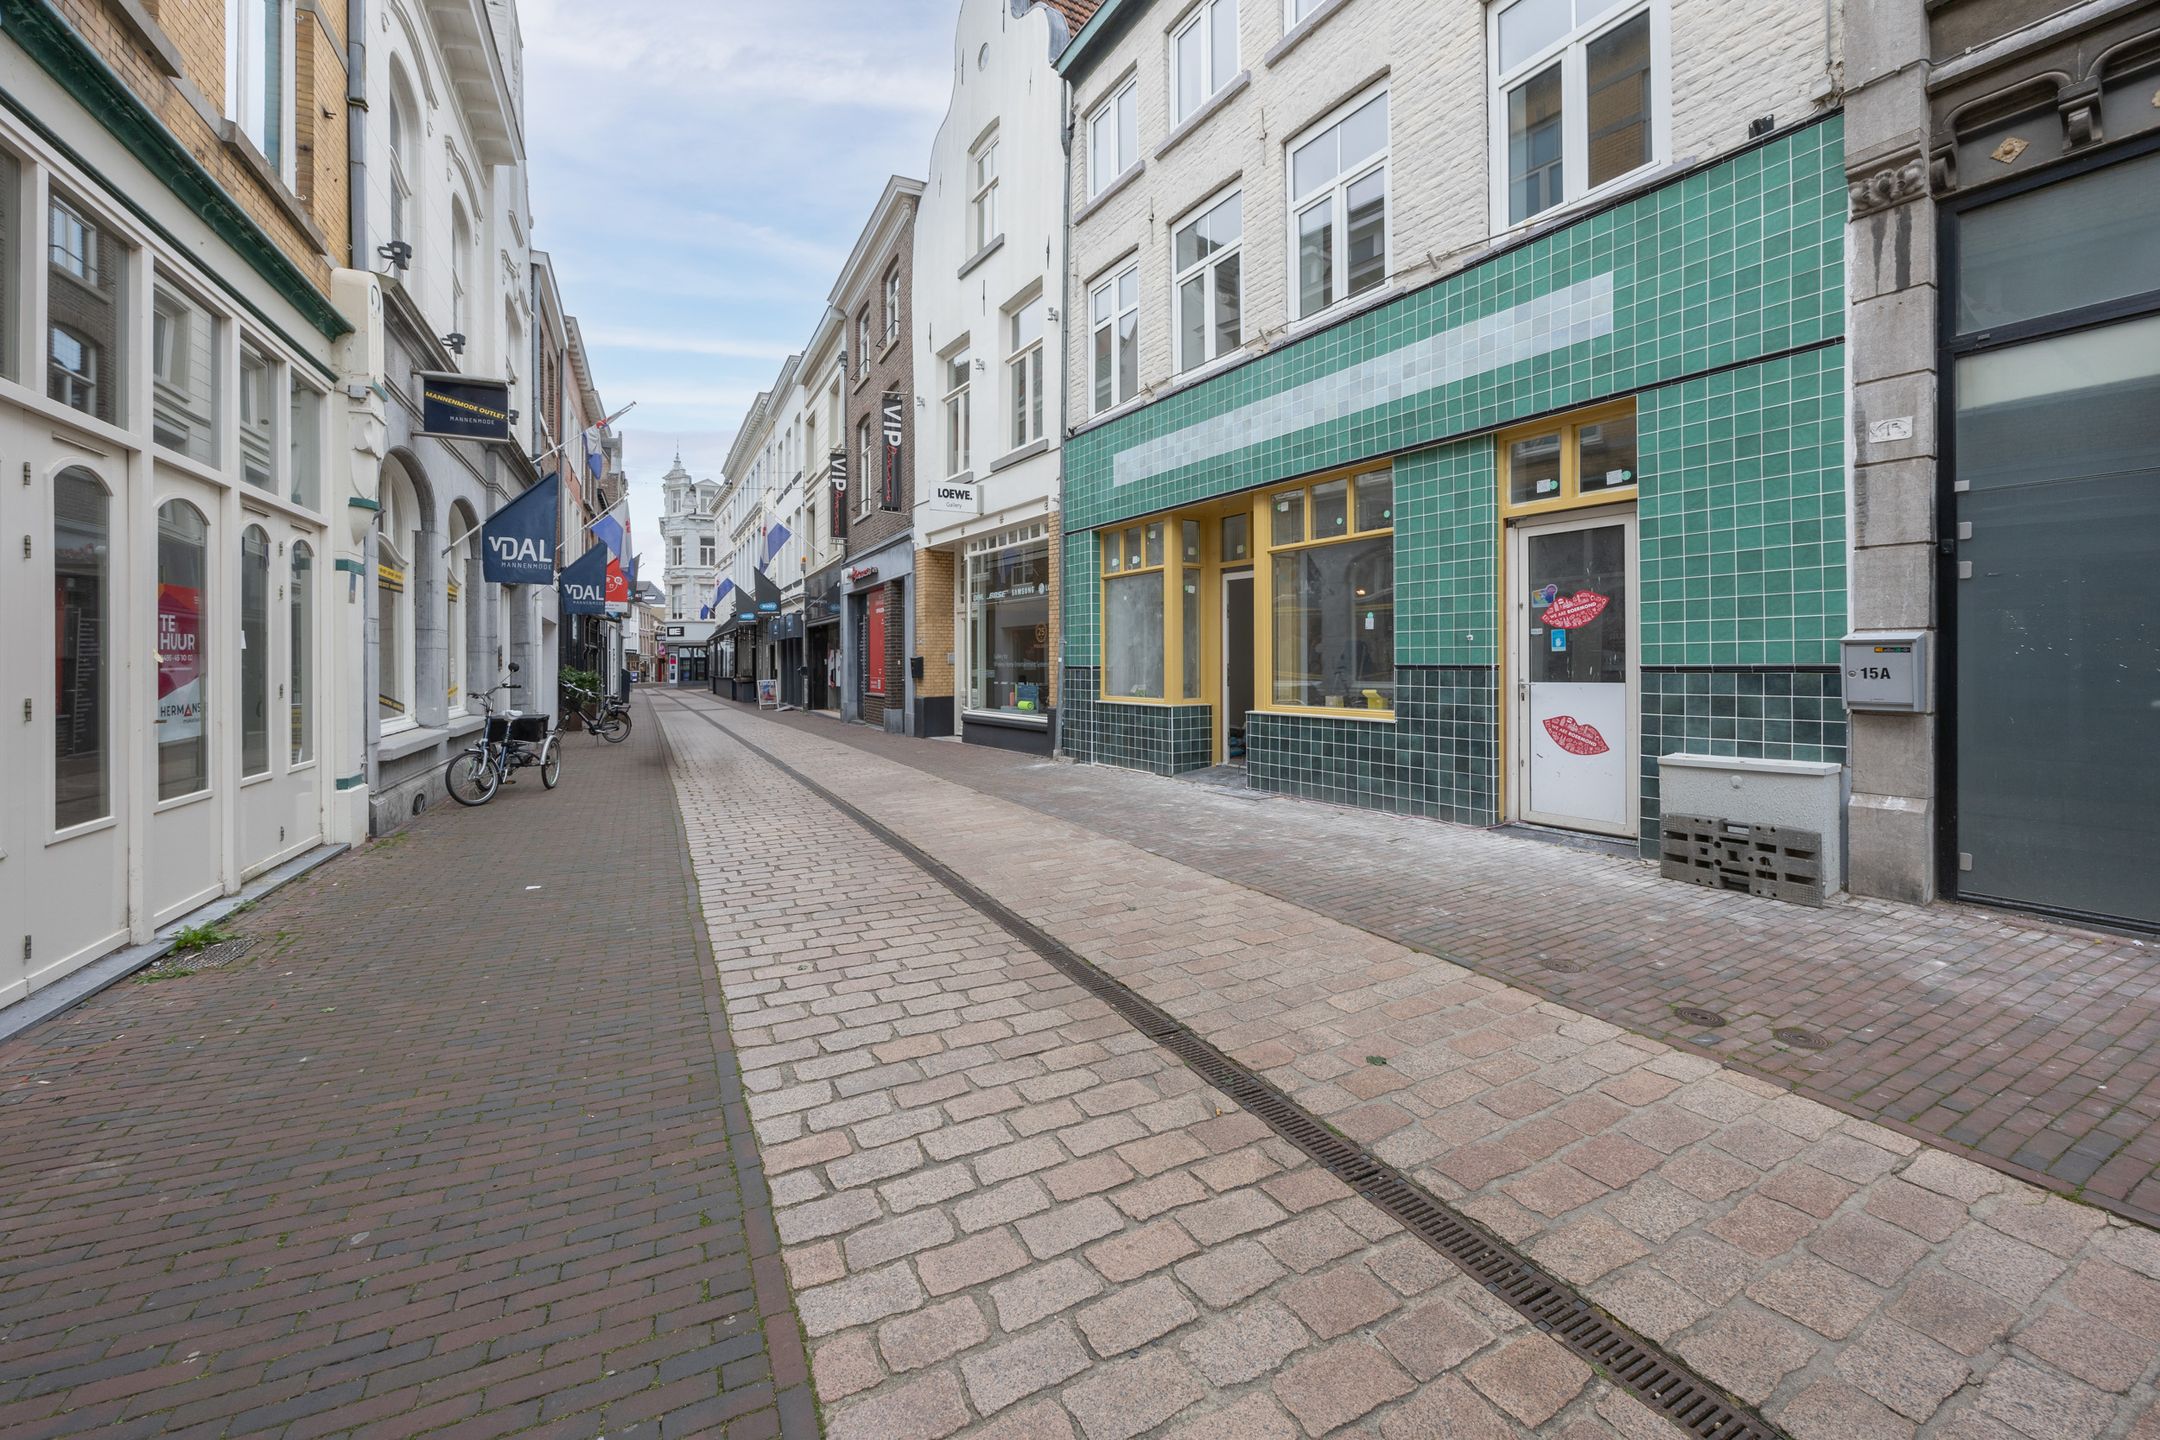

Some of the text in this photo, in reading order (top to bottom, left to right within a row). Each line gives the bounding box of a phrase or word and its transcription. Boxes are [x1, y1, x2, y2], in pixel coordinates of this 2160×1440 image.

[425, 391, 505, 420] MANNENMODE OUTLET
[449, 415, 495, 425] MANNENMODE
[883, 404, 902, 447] VIP
[831, 458, 847, 492] VIP
[937, 487, 973, 501] LOEWE.
[501, 561, 552, 570] MANNENMODE
[1567, 601, 1597, 614] ROERMOND
[160, 614, 176, 633] TE
[160, 633, 195, 651] HUUR
[1860, 667, 1891, 680] 15A
[1567, 731, 1597, 747] ROERMOND
